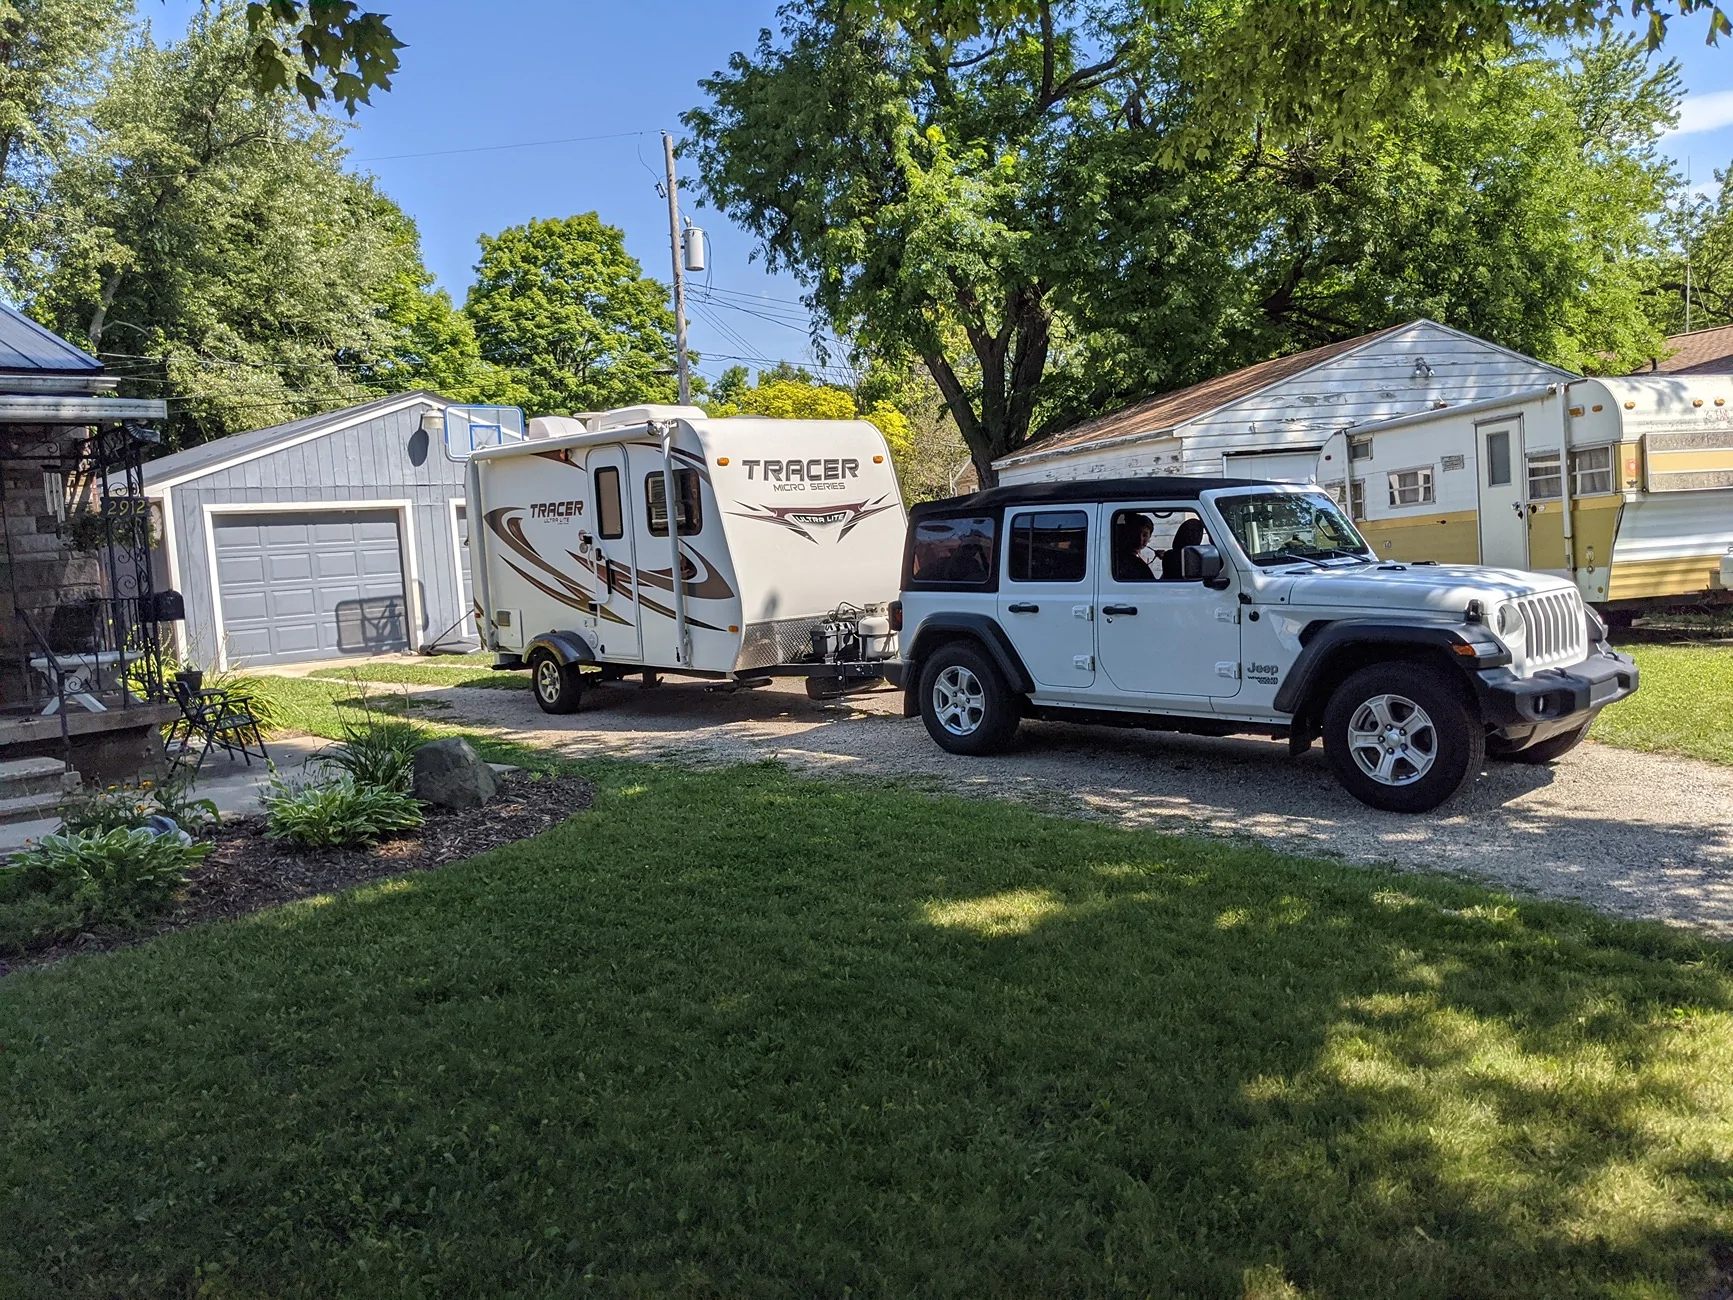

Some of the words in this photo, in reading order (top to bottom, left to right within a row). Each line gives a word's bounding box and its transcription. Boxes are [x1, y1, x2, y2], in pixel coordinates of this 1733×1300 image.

[741, 458, 860, 482] TRACER
[773, 483, 806, 492] MICRO
[809, 482, 846, 491] SERIES
[107, 500, 146, 516] 2912
[530, 500, 584, 518] TRACER
[795, 515, 826, 524] ULTRA
[826, 514, 846, 523] LITE
[1247, 662, 1279, 676] Jeep
